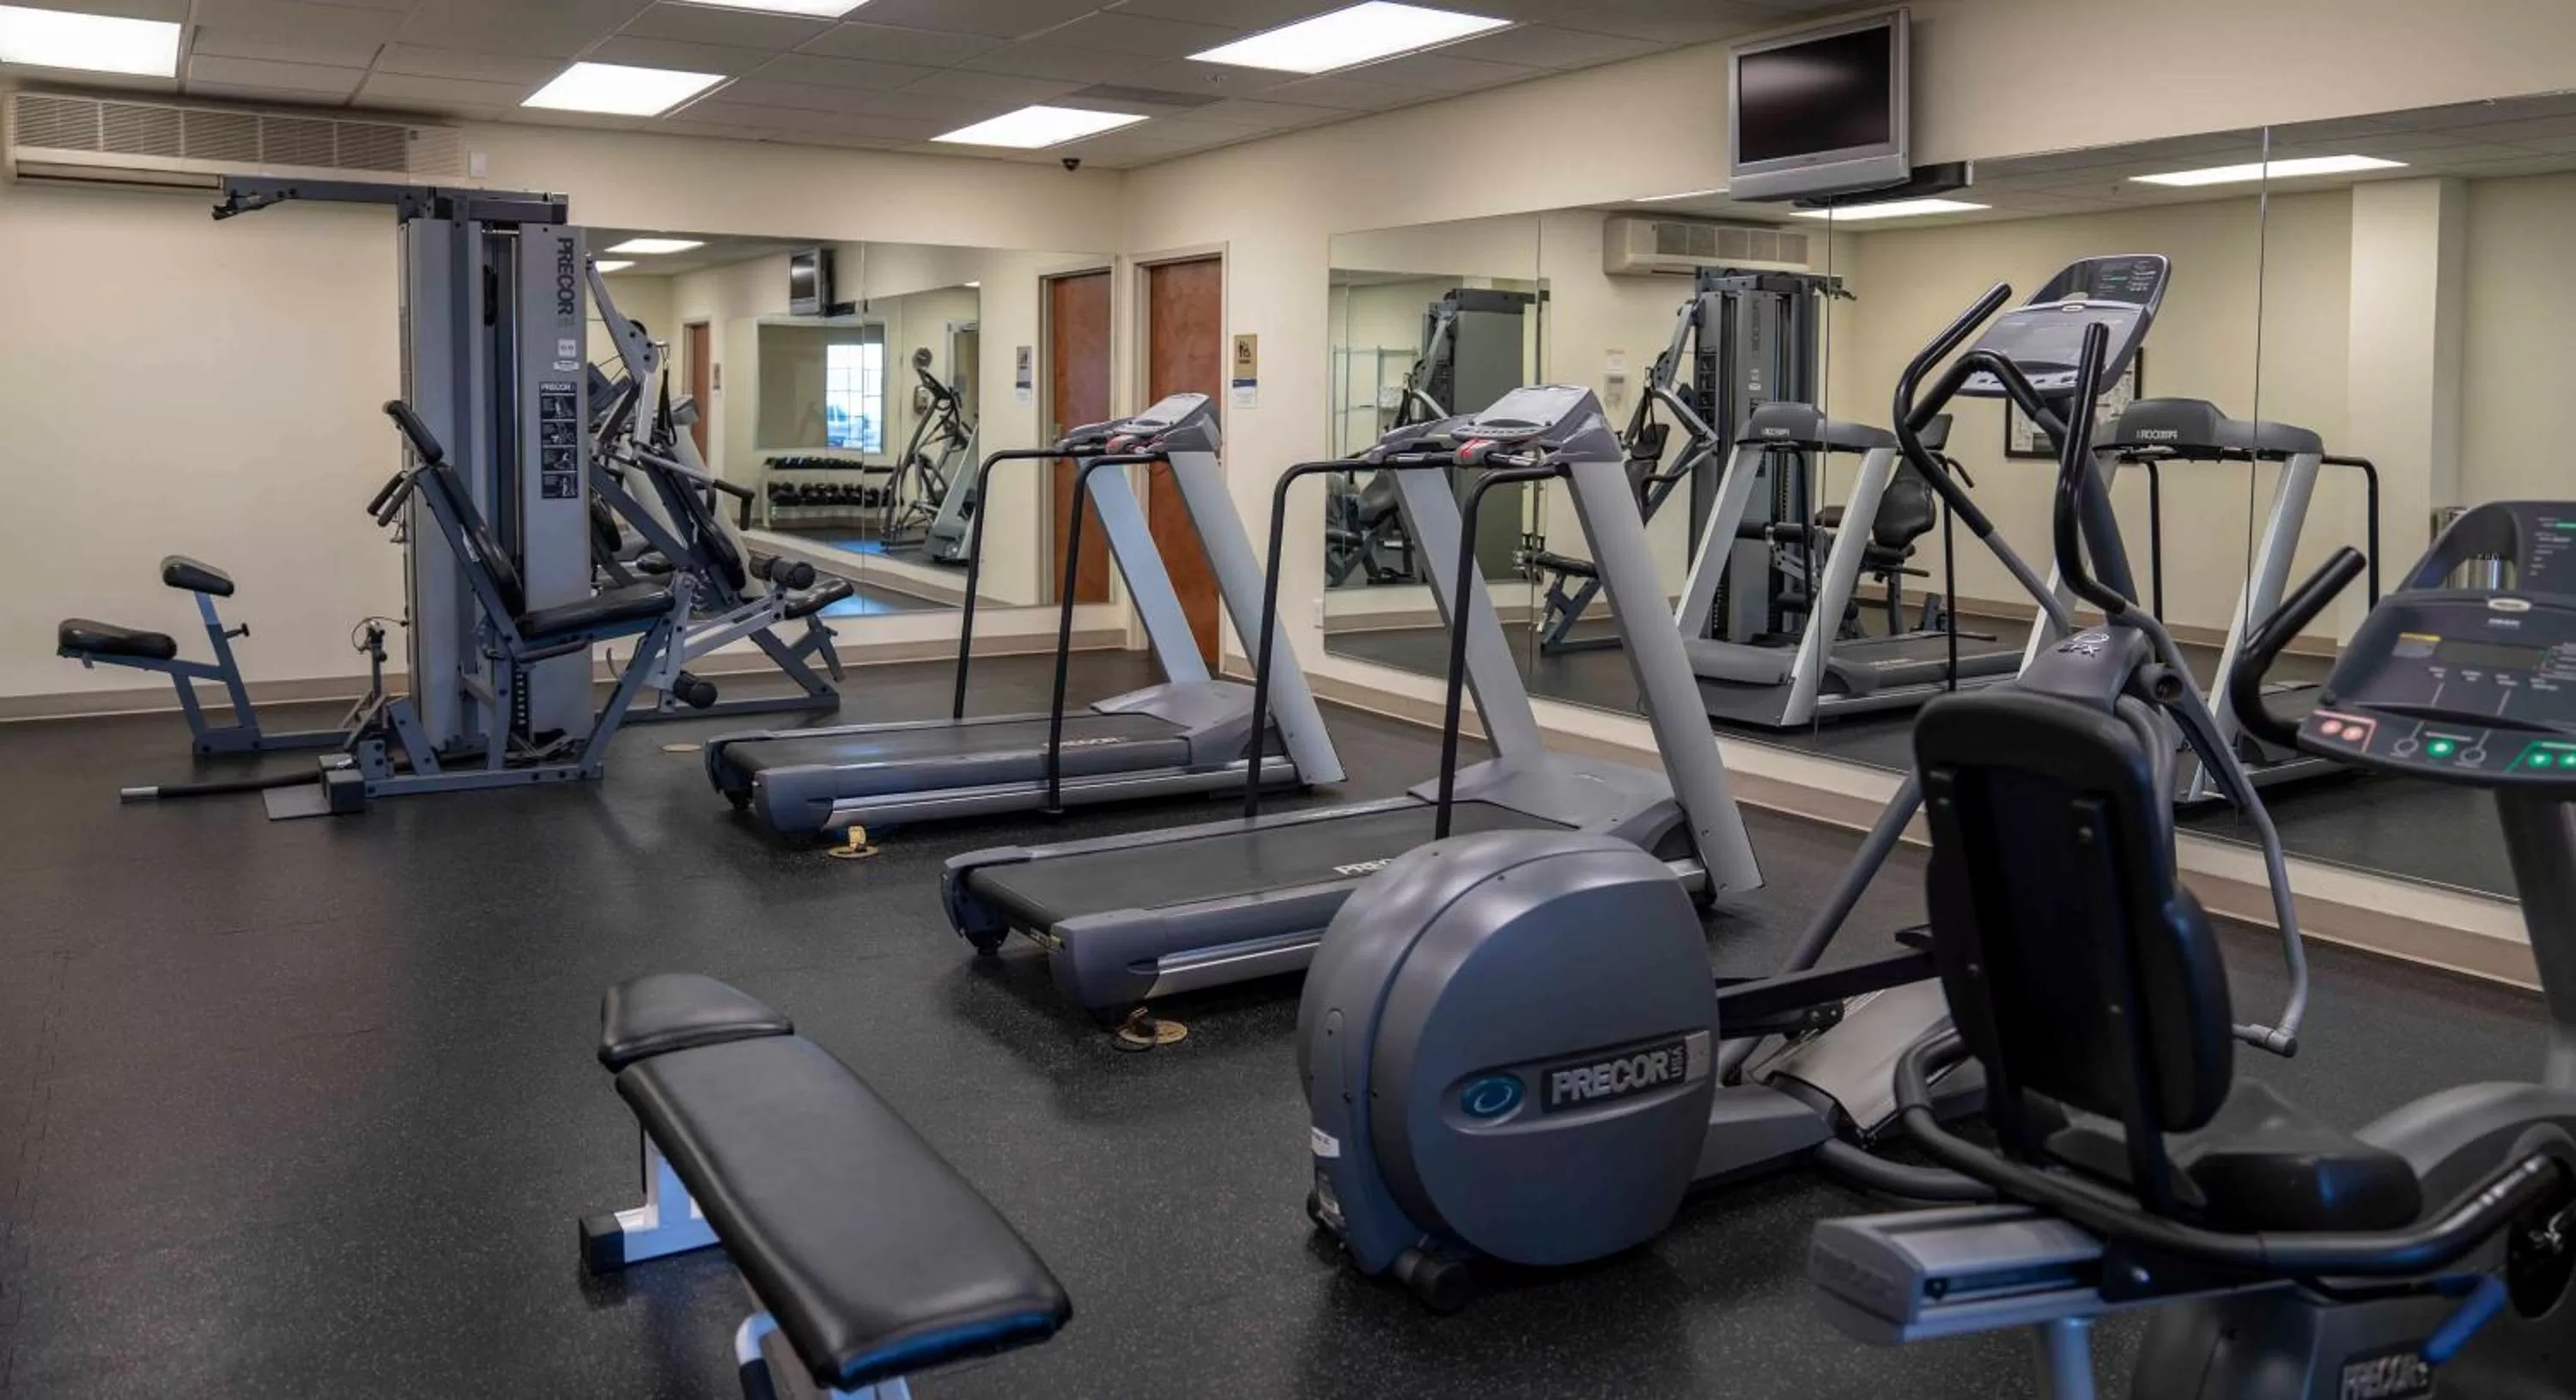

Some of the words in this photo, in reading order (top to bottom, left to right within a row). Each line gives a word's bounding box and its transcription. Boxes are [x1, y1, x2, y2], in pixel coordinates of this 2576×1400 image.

[556, 237, 575, 315] PRECOR
[1552, 1050, 1668, 1106] PRECOR
[1671, 1045, 1684, 1078] USA
